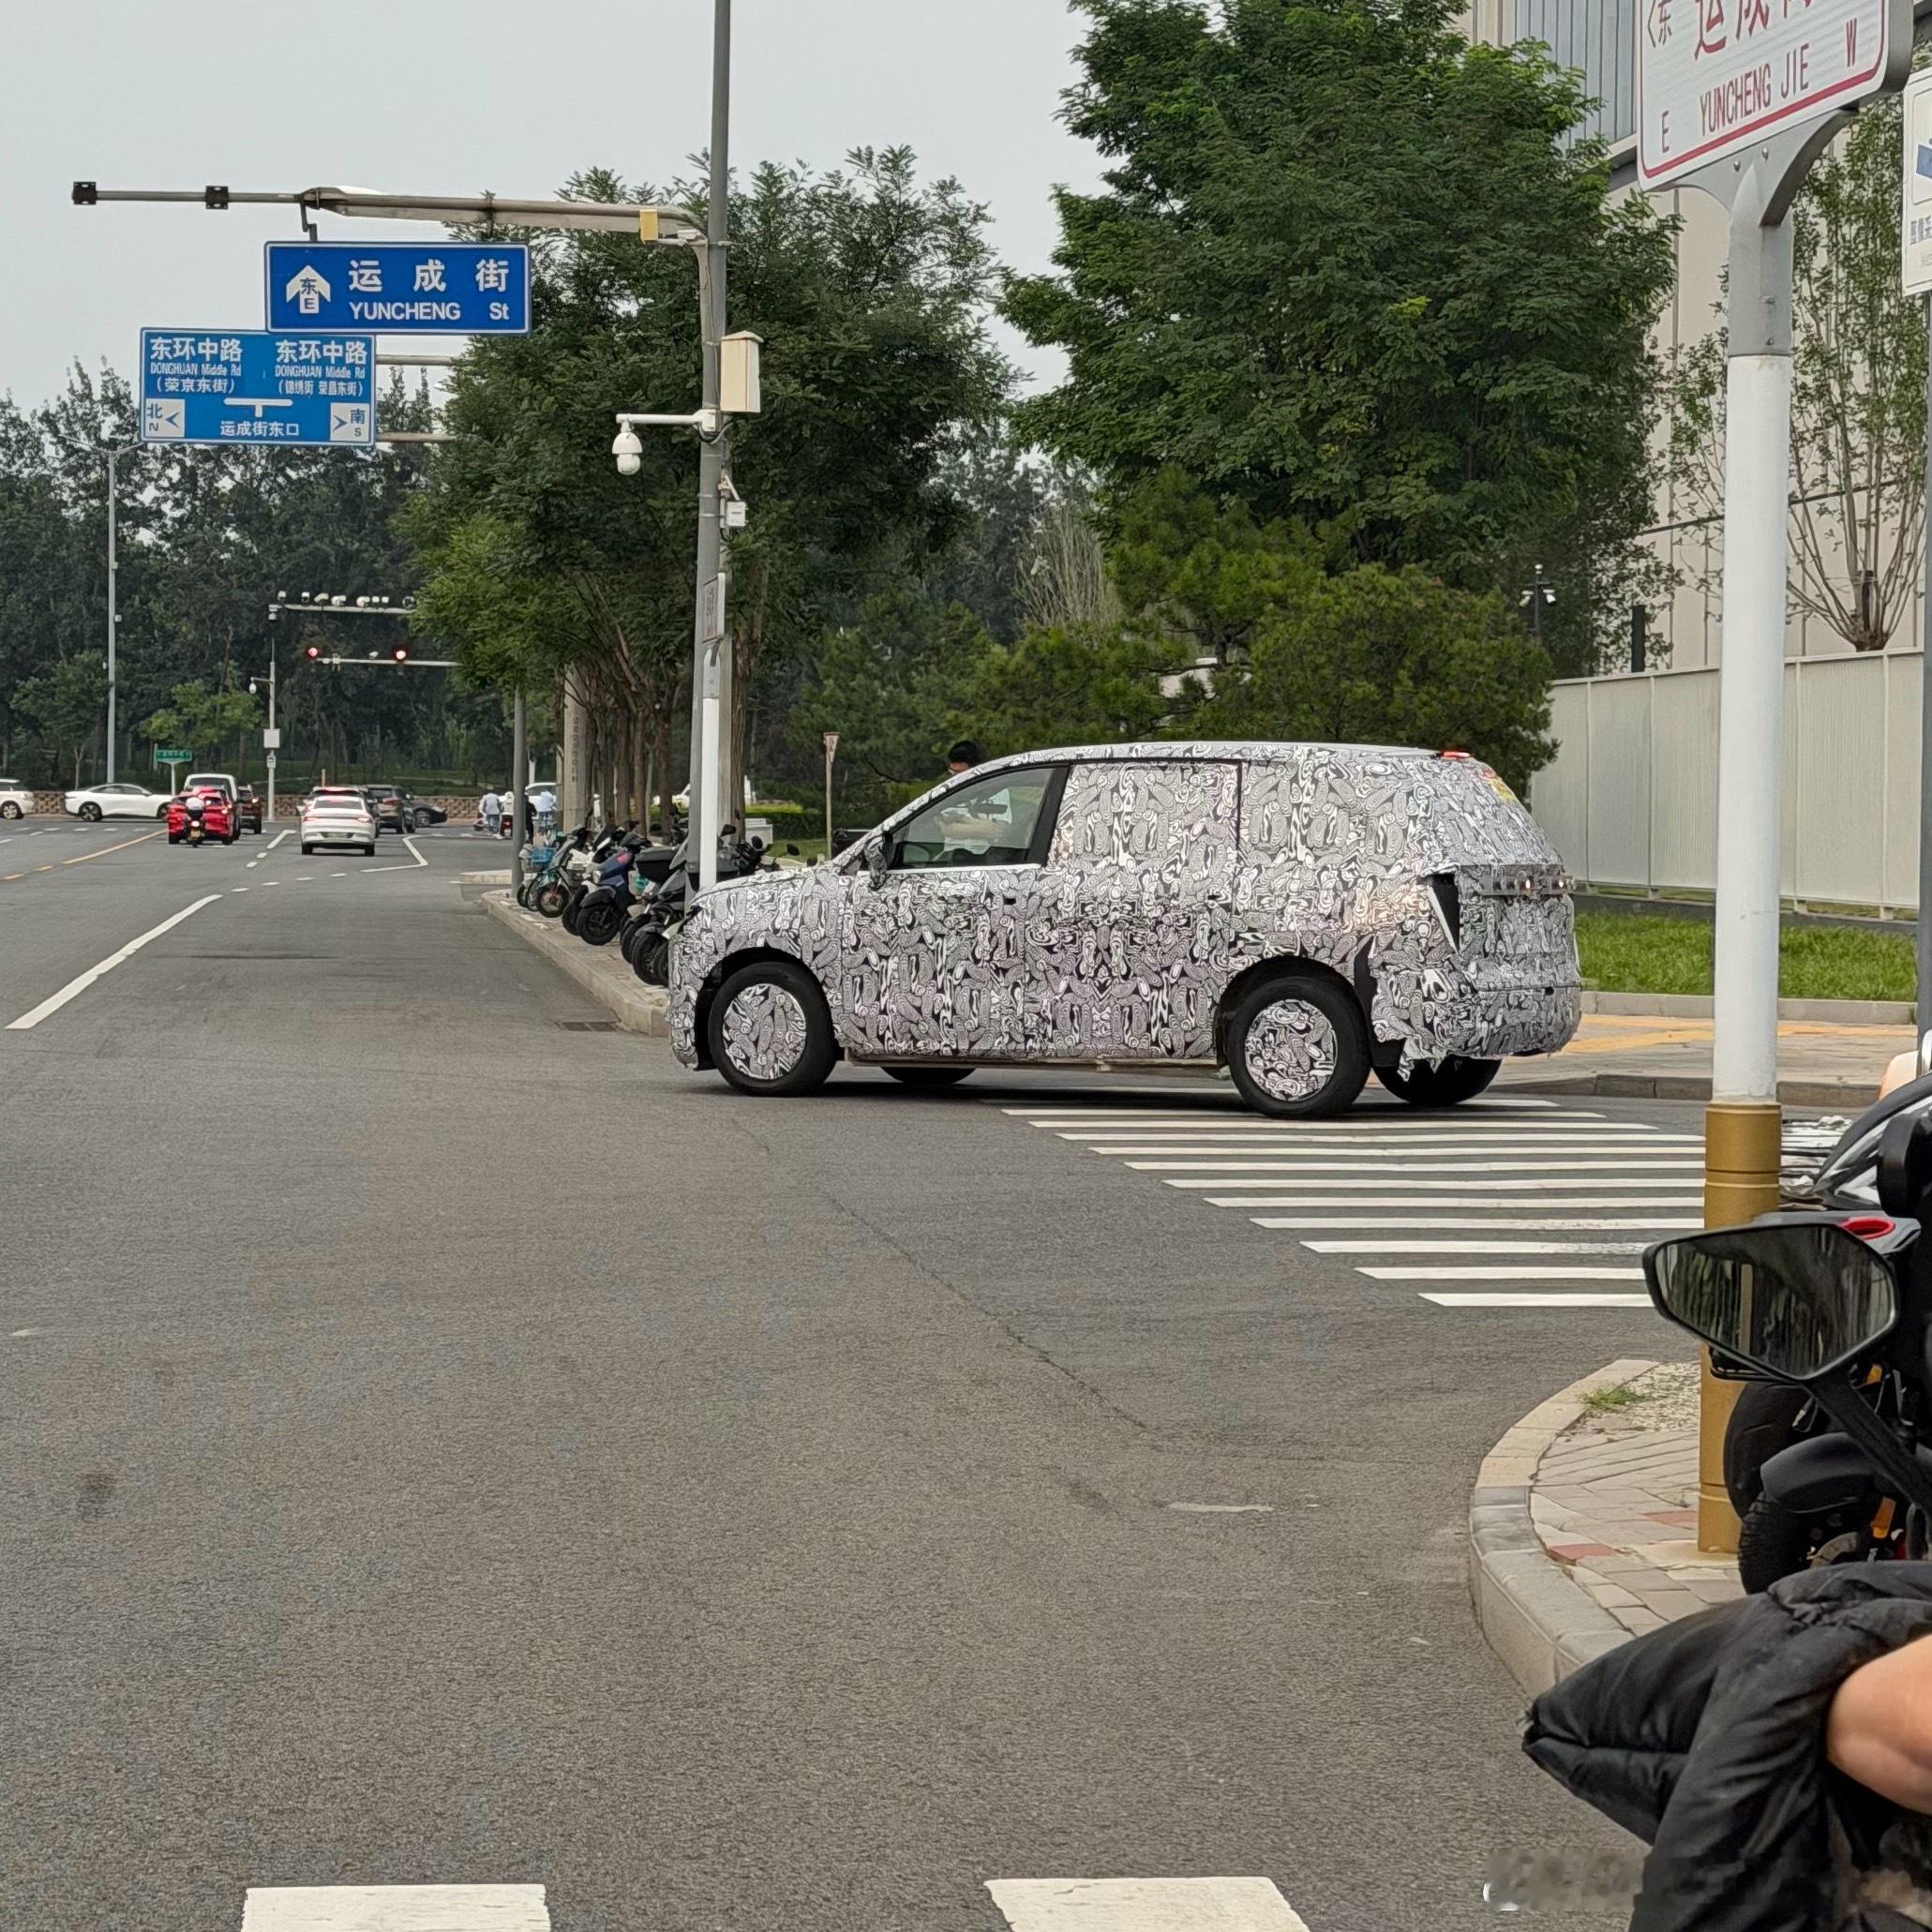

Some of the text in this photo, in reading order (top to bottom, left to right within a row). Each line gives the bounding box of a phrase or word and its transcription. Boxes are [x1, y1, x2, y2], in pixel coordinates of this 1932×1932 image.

[1845, 18, 1857, 67] W
[1700, 43, 1810, 137] YUNCHENG JIE
[1661, 110, 1670, 154] E
[349, 259, 509, 292] 运成街
[299, 277, 318, 295] 东
[305, 297, 315, 310] E
[349, 302, 510, 321] YUNCHENG St
[150, 337, 243, 362] 东环中路
[276, 339, 367, 365] 东环中路
[150, 362, 198, 375] DONGHUAN
[231, 364, 242, 377] Rd
[275, 365, 322, 378] DONGHUAN
[354, 366, 366, 380] Rd
[147, 403, 163, 419] 北
[350, 408, 367, 425] 南
[150, 423, 159, 432] N
[219, 420, 299, 438] 运成街东口
[353, 427, 363, 438] S
